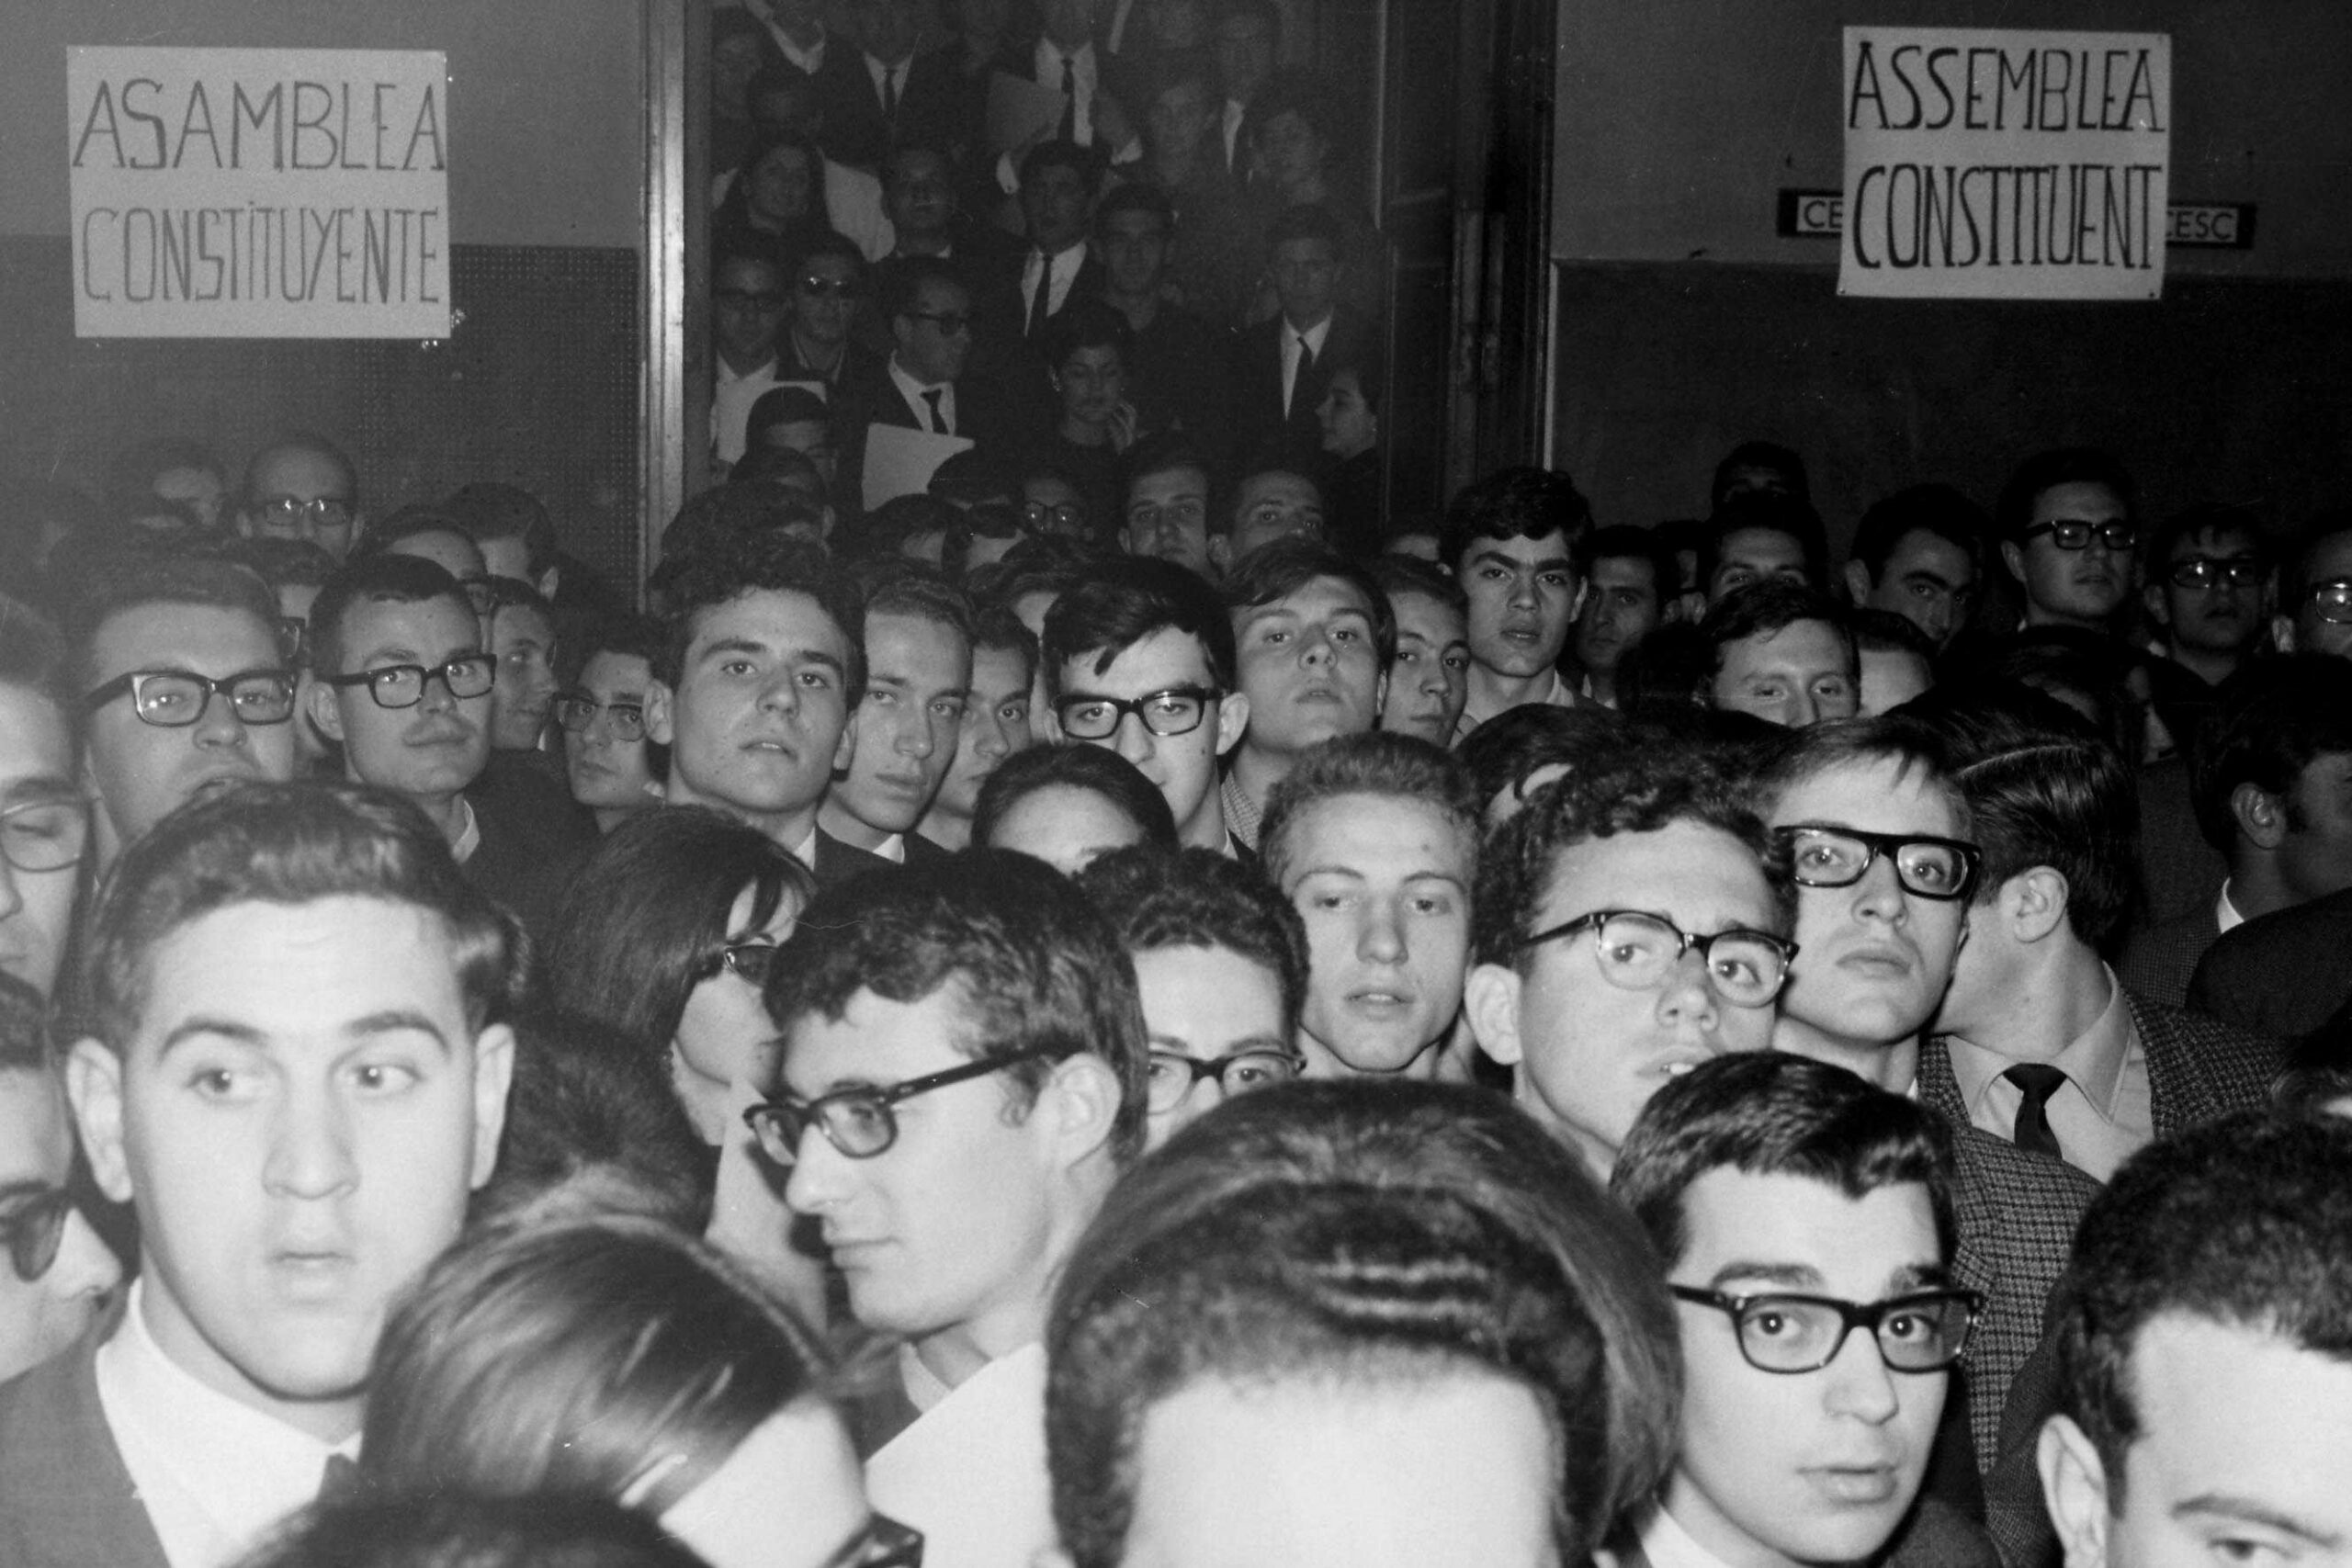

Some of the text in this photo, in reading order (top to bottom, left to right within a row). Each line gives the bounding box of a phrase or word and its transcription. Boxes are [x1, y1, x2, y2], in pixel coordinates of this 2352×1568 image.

[72, 77, 446, 173] ASAMBLEA
[1849, 41, 2165, 131] ASSEMBLEA
[83, 200, 439, 305] CONSTITUYENTE
[1852, 164, 2163, 270] CONSTITUENT
